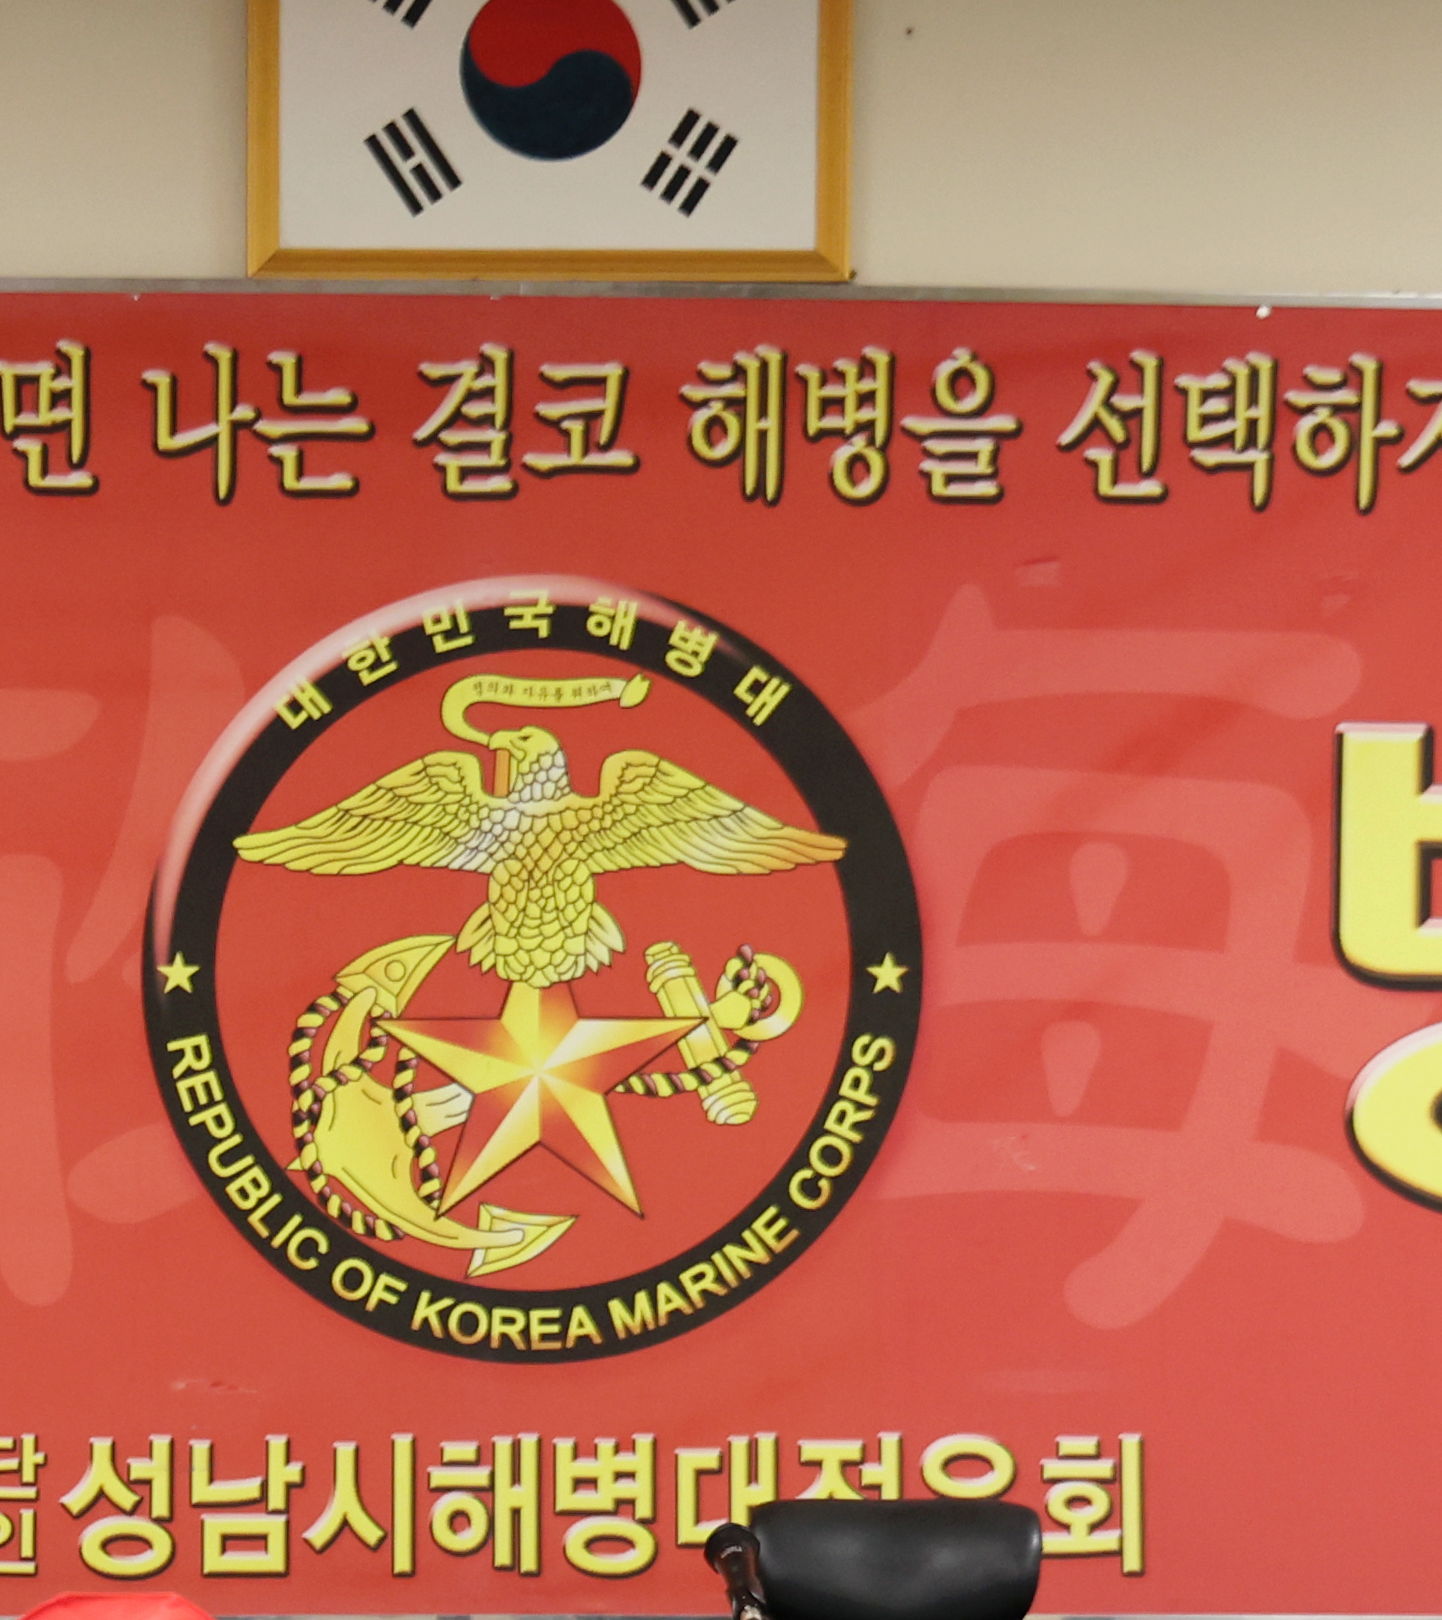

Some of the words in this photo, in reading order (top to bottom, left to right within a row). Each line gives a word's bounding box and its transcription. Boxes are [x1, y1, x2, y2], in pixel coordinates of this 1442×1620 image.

[141, 342, 373, 502] 나는
[412, 342, 638, 497] 결코
[679, 344, 1020, 505] 해병을
[165, 1033, 331, 1271] REPUBLIC
[330, 1257, 408, 1313] OF
[410, 1289, 604, 1351] KOREA
[606, 1203, 801, 1341] MARINE
[788, 1032, 897, 1212] CORPS
